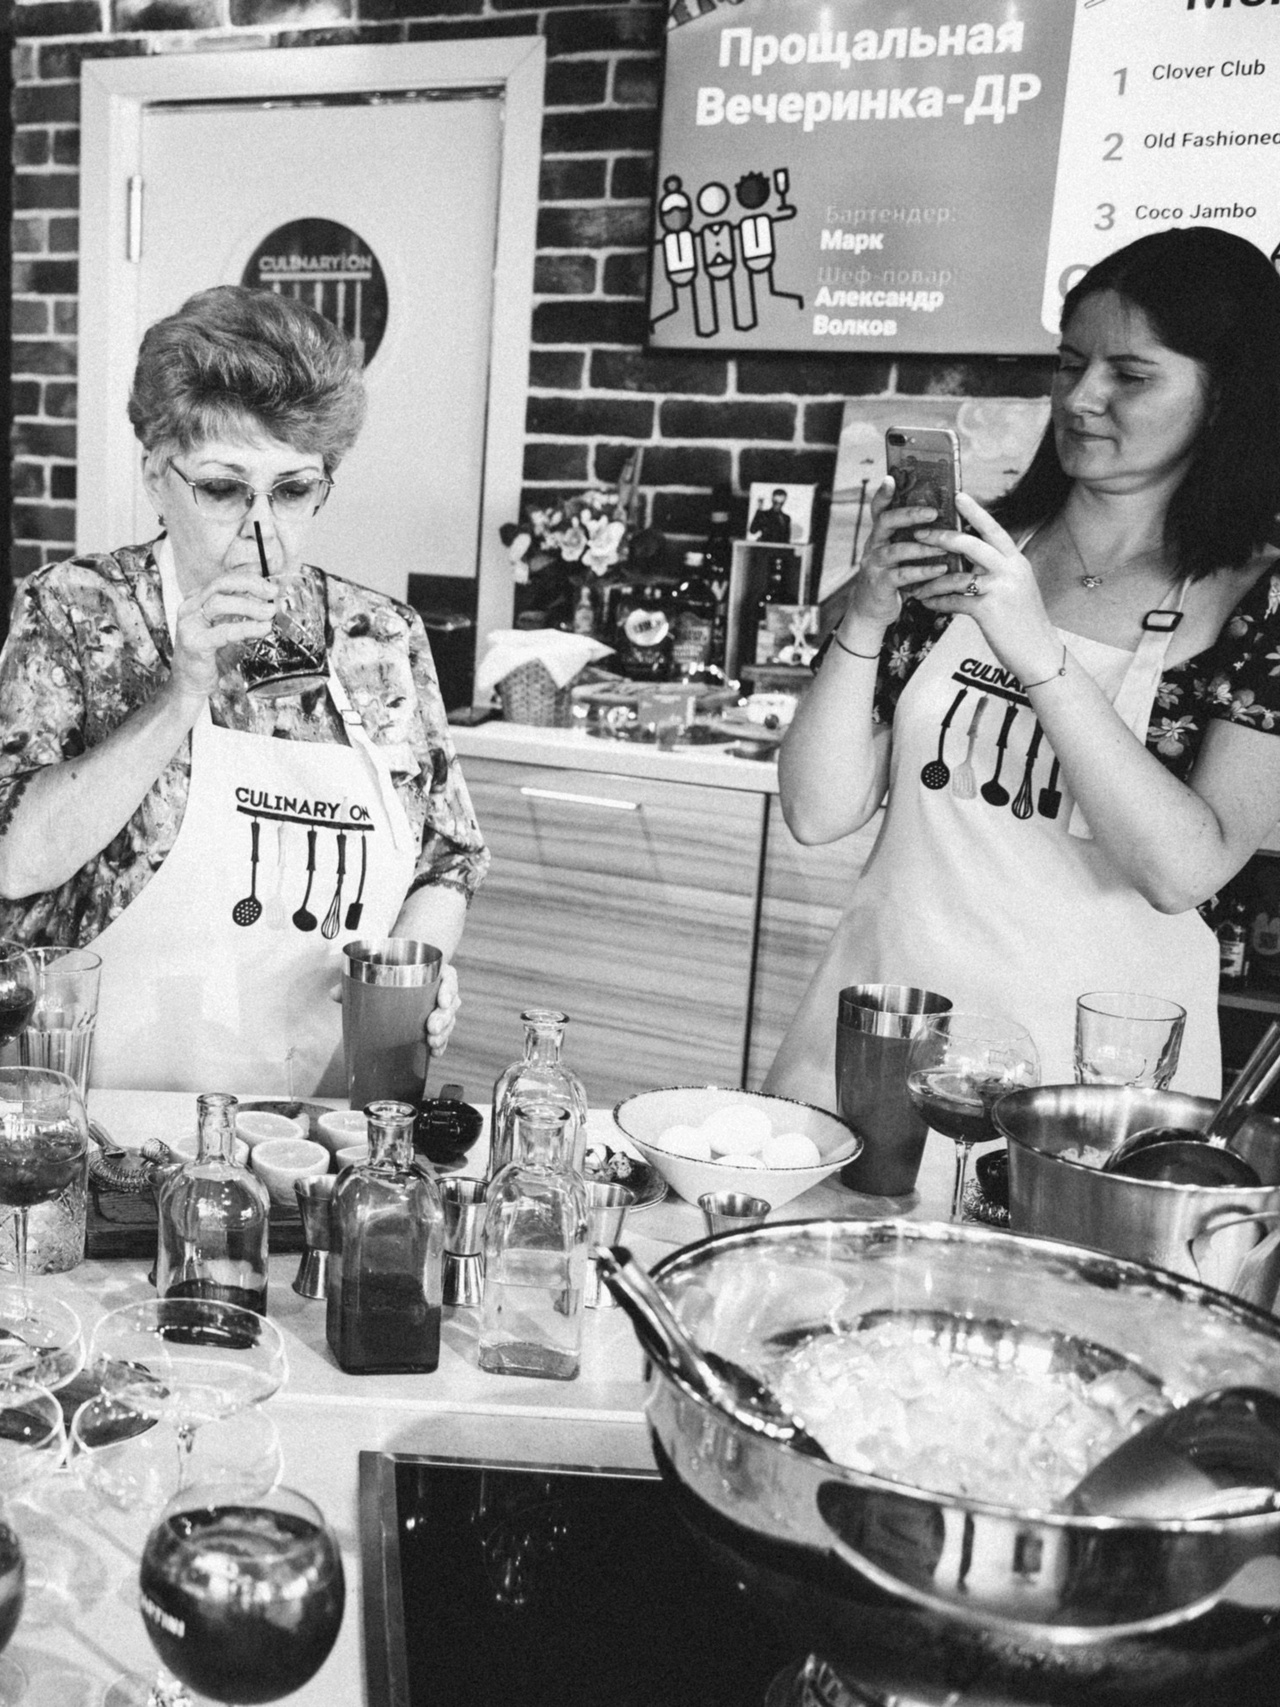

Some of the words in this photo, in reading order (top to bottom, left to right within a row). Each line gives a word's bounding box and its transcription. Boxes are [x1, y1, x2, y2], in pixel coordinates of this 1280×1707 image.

[719, 20, 1024, 76] Прощальная
[1113, 67, 1127, 96] 1
[1152, 64, 1215, 81] Clover
[1220, 59, 1266, 77] Club
[696, 73, 1042, 132] Вечеринка-ДР
[1102, 132, 1124, 161] 2
[1143, 133, 1176, 149] Old
[1094, 203, 1116, 231] 3
[1135, 205, 1183, 220] Coco
[1189, 203, 1257, 219] Jambo
[820, 229, 884, 255] Марк
[259, 254, 340, 271] CULINARY
[814, 286, 944, 312] Александр
[812, 314, 898, 336] Волков
[235, 787, 341, 819] CULINARY
